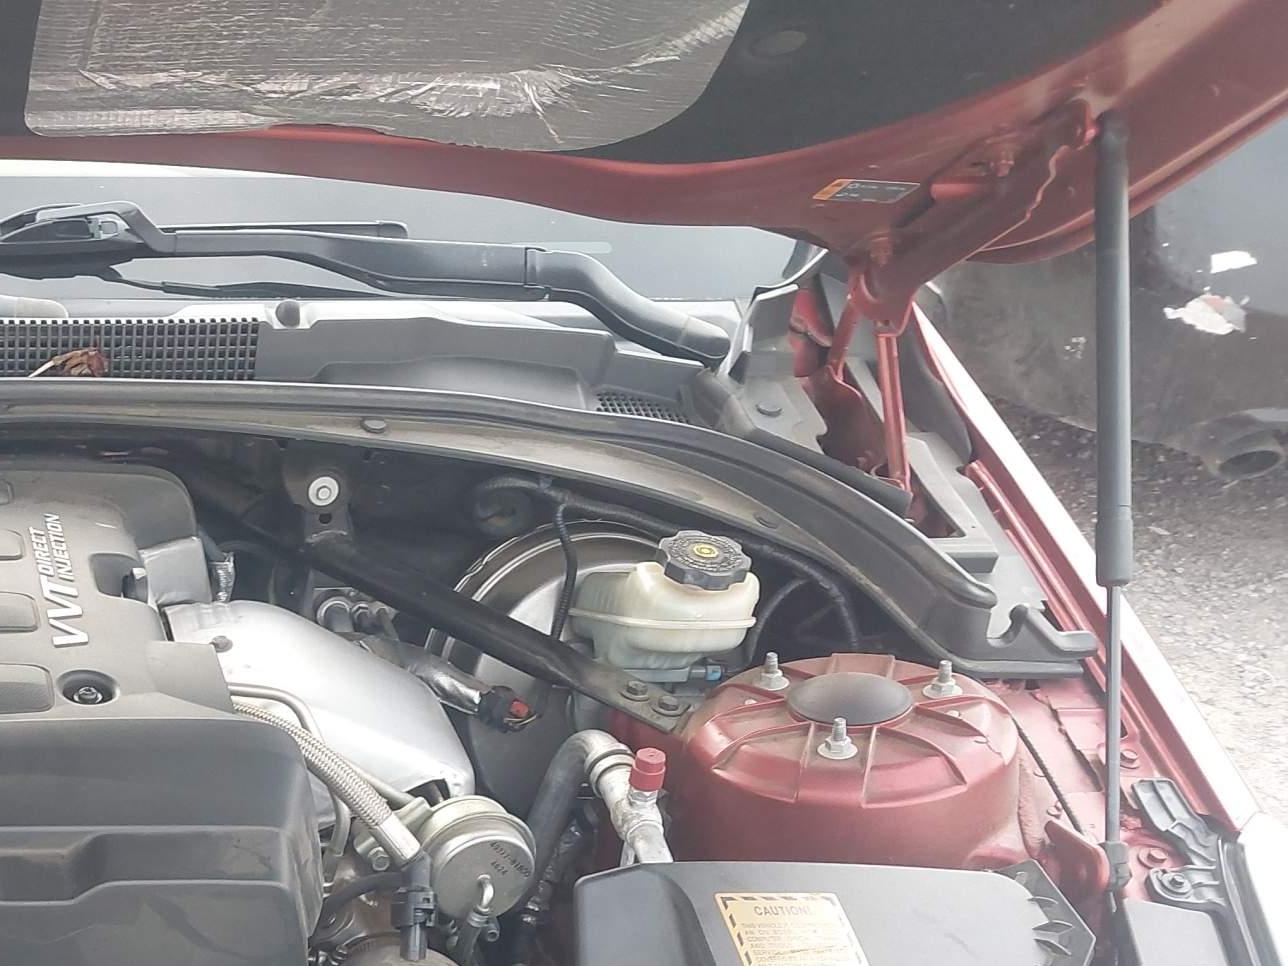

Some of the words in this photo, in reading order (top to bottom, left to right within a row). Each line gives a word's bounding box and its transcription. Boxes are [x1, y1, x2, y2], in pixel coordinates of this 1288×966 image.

[28, 526, 55, 578] DIRECT
[43, 512, 75, 583] INJECTION
[39, 573, 89, 649] VVT
[753, 905, 813, 917] CAUTION!
